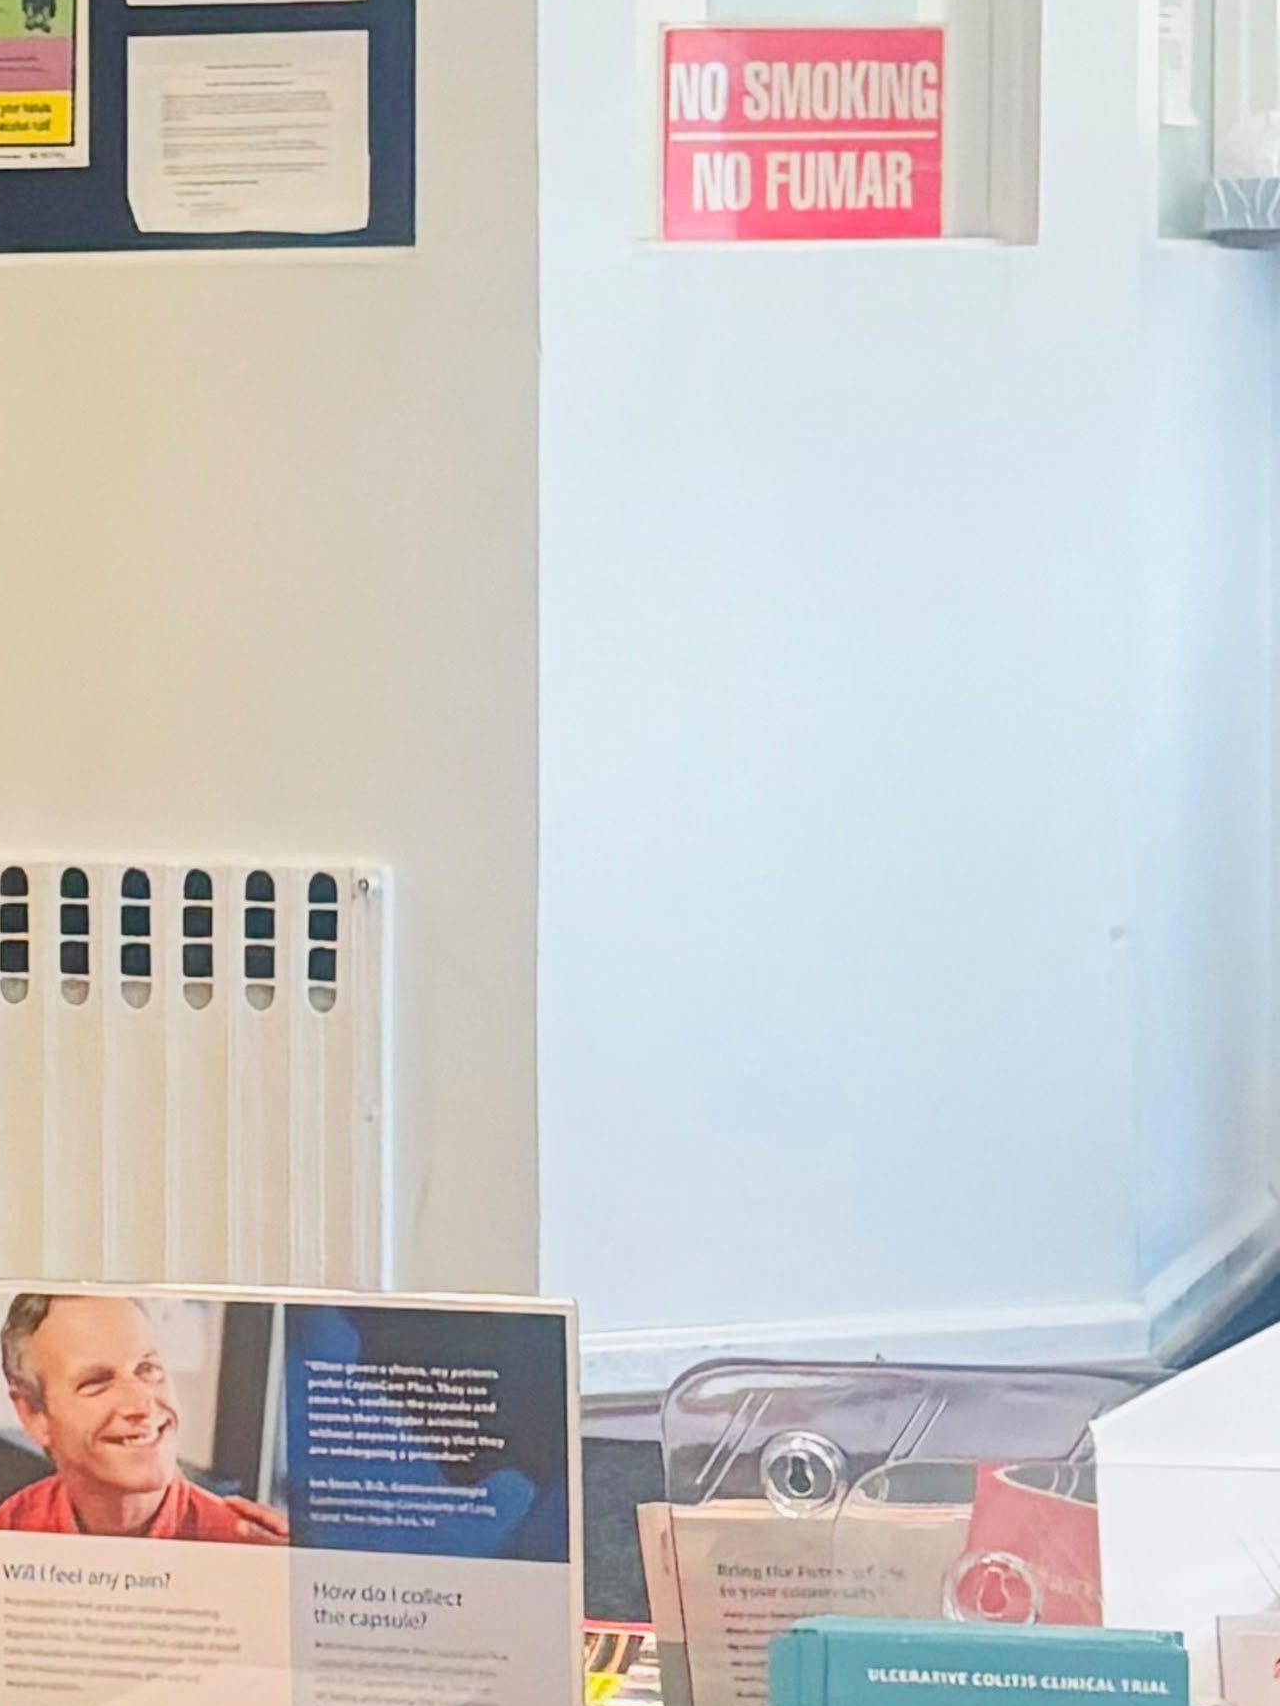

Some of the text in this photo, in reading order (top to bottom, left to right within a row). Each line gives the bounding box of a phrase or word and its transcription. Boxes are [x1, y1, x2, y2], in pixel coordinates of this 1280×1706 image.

[669, 60, 938, 121] NO SMOKING
[692, 150, 913, 212] NO FUMAR
[3, 1563, 35, 1581] Will
[49, 1565, 82, 1585] feel
[88, 1571, 118, 1591] any
[124, 1572, 171, 1591] pain?
[314, 1582, 356, 1601] How
[361, 1585, 386, 1603] do
[401, 1588, 463, 1607] collect
[314, 1608, 427, 1631] the capsule?
[867, 1667, 1169, 1694] ULCERATIVE COLITIS CLINICAL TRIAL
